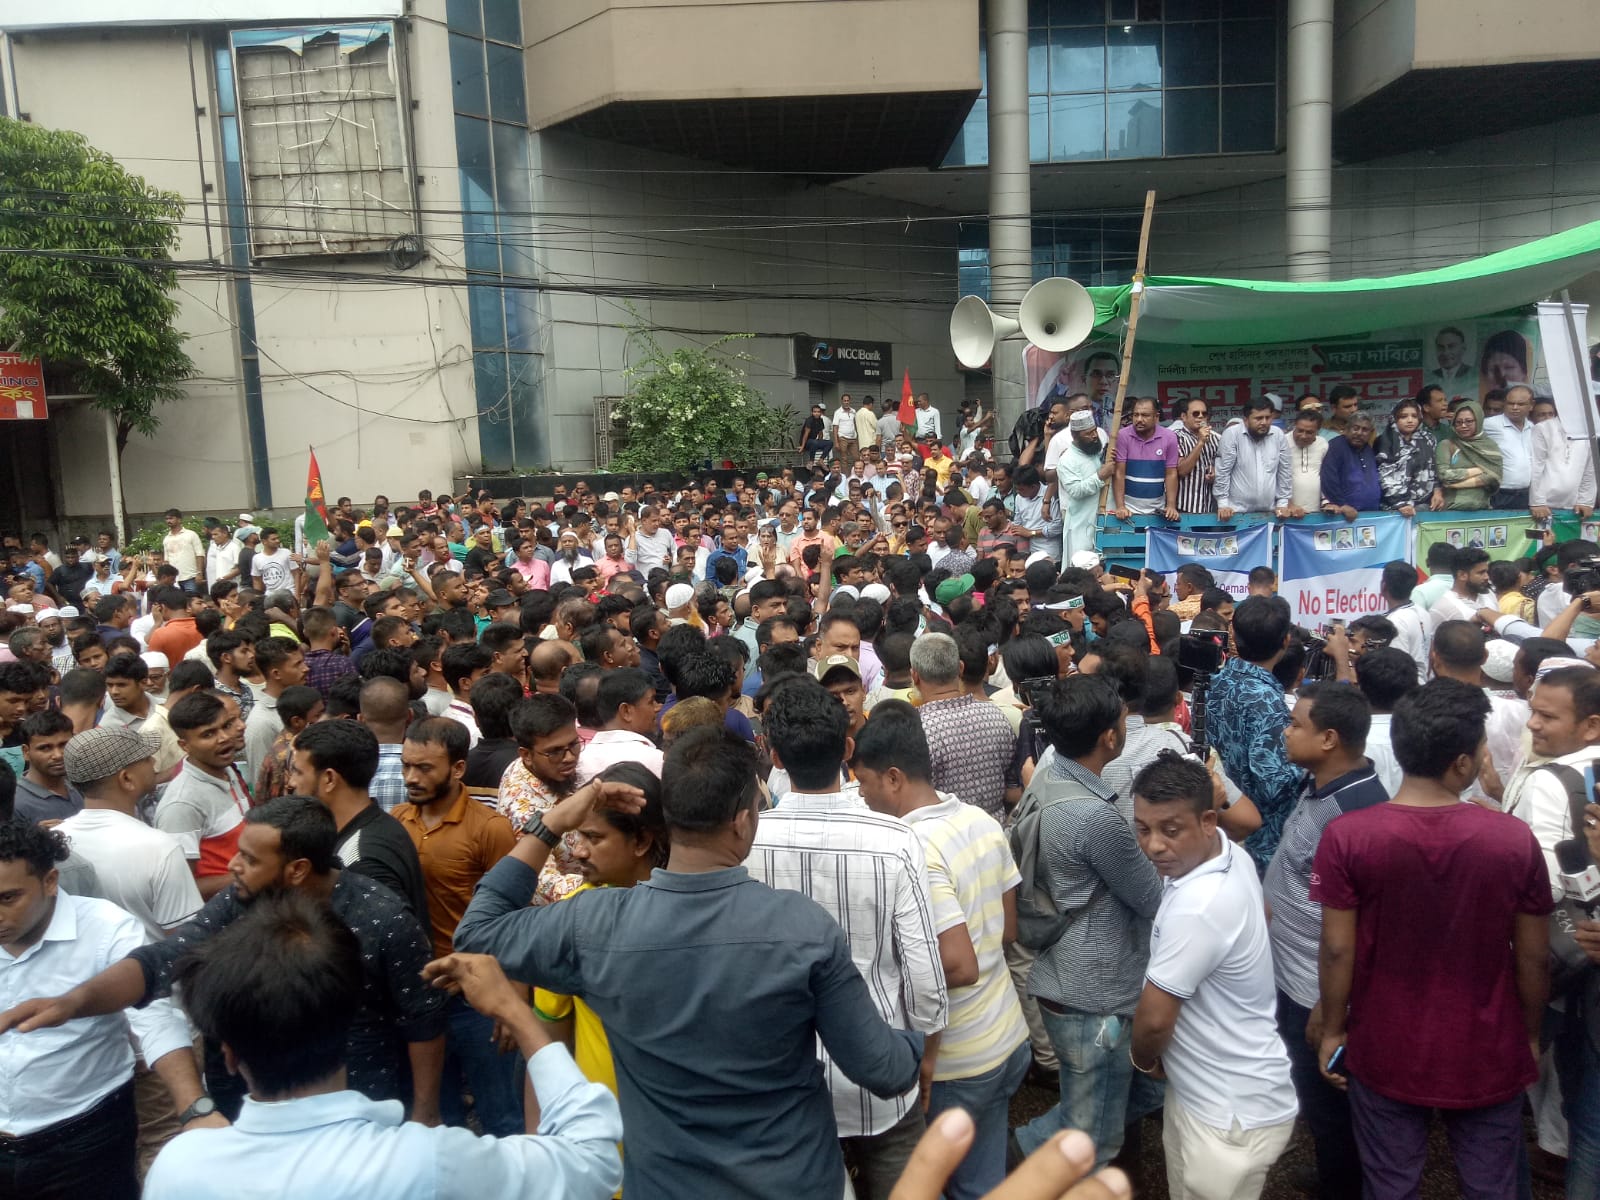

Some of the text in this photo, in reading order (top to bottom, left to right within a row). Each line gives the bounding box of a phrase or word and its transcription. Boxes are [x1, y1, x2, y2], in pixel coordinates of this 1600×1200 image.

[1328, 351, 1361, 365] দফা
[1367, 343, 1421, 363] দাবিতে
[1298, 587, 1388, 615] No Election
